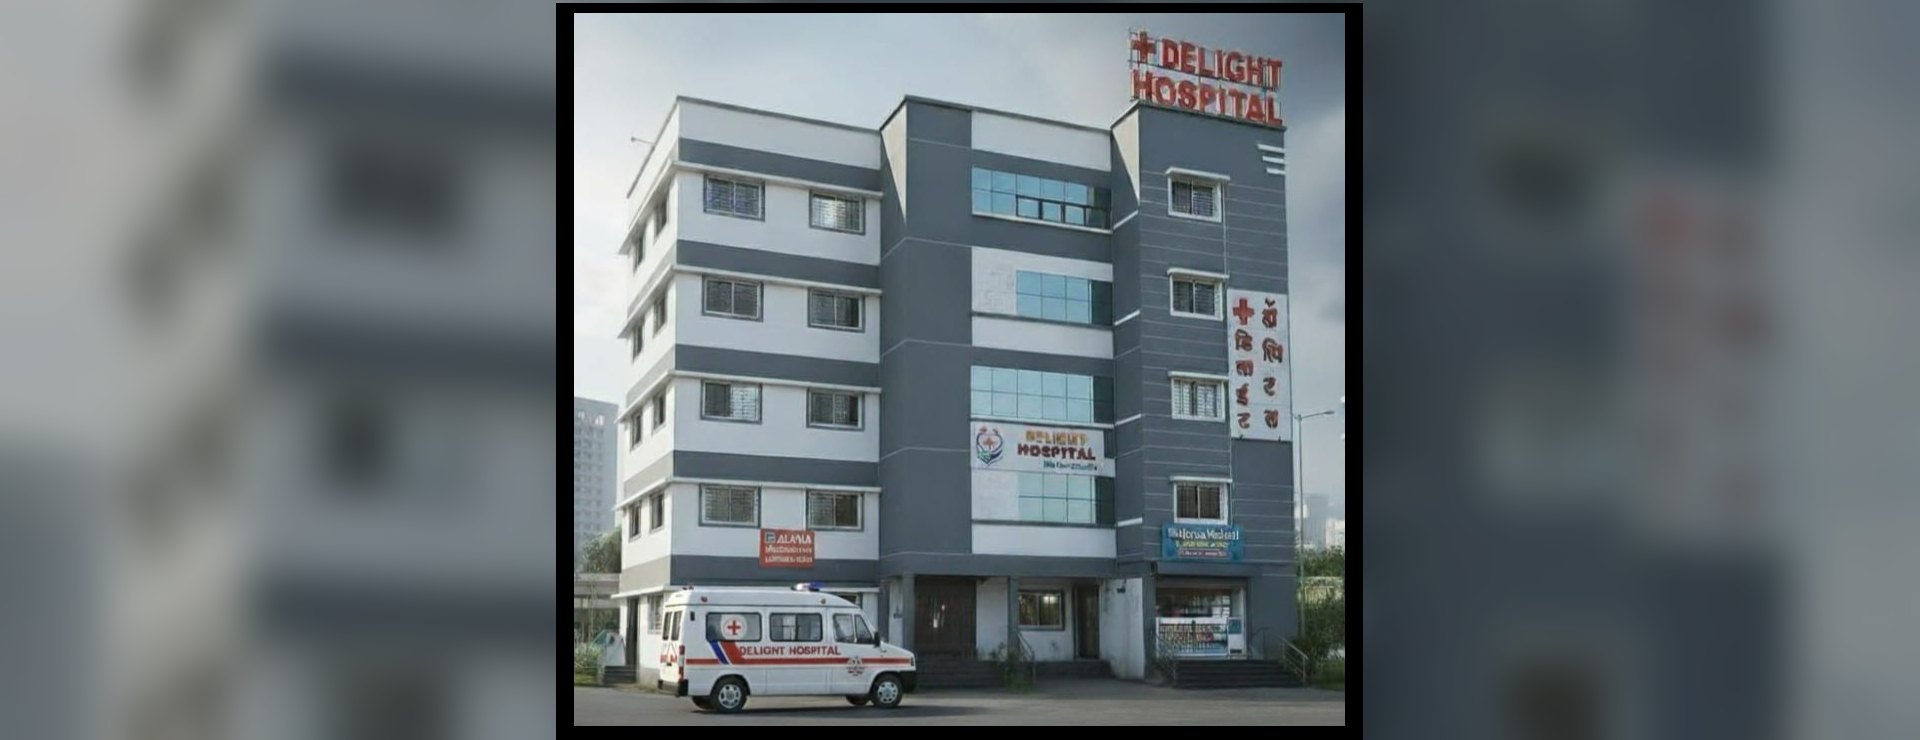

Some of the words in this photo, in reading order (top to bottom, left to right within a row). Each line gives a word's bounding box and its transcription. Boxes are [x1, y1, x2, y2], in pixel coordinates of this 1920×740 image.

[1161, 38, 1283, 89] DELIGHT
[1131, 69, 1283, 126] HOSPITAL
[1017, 443, 1096, 461] HOSPITAL
[788, 645, 841, 656] HOSPITAL
